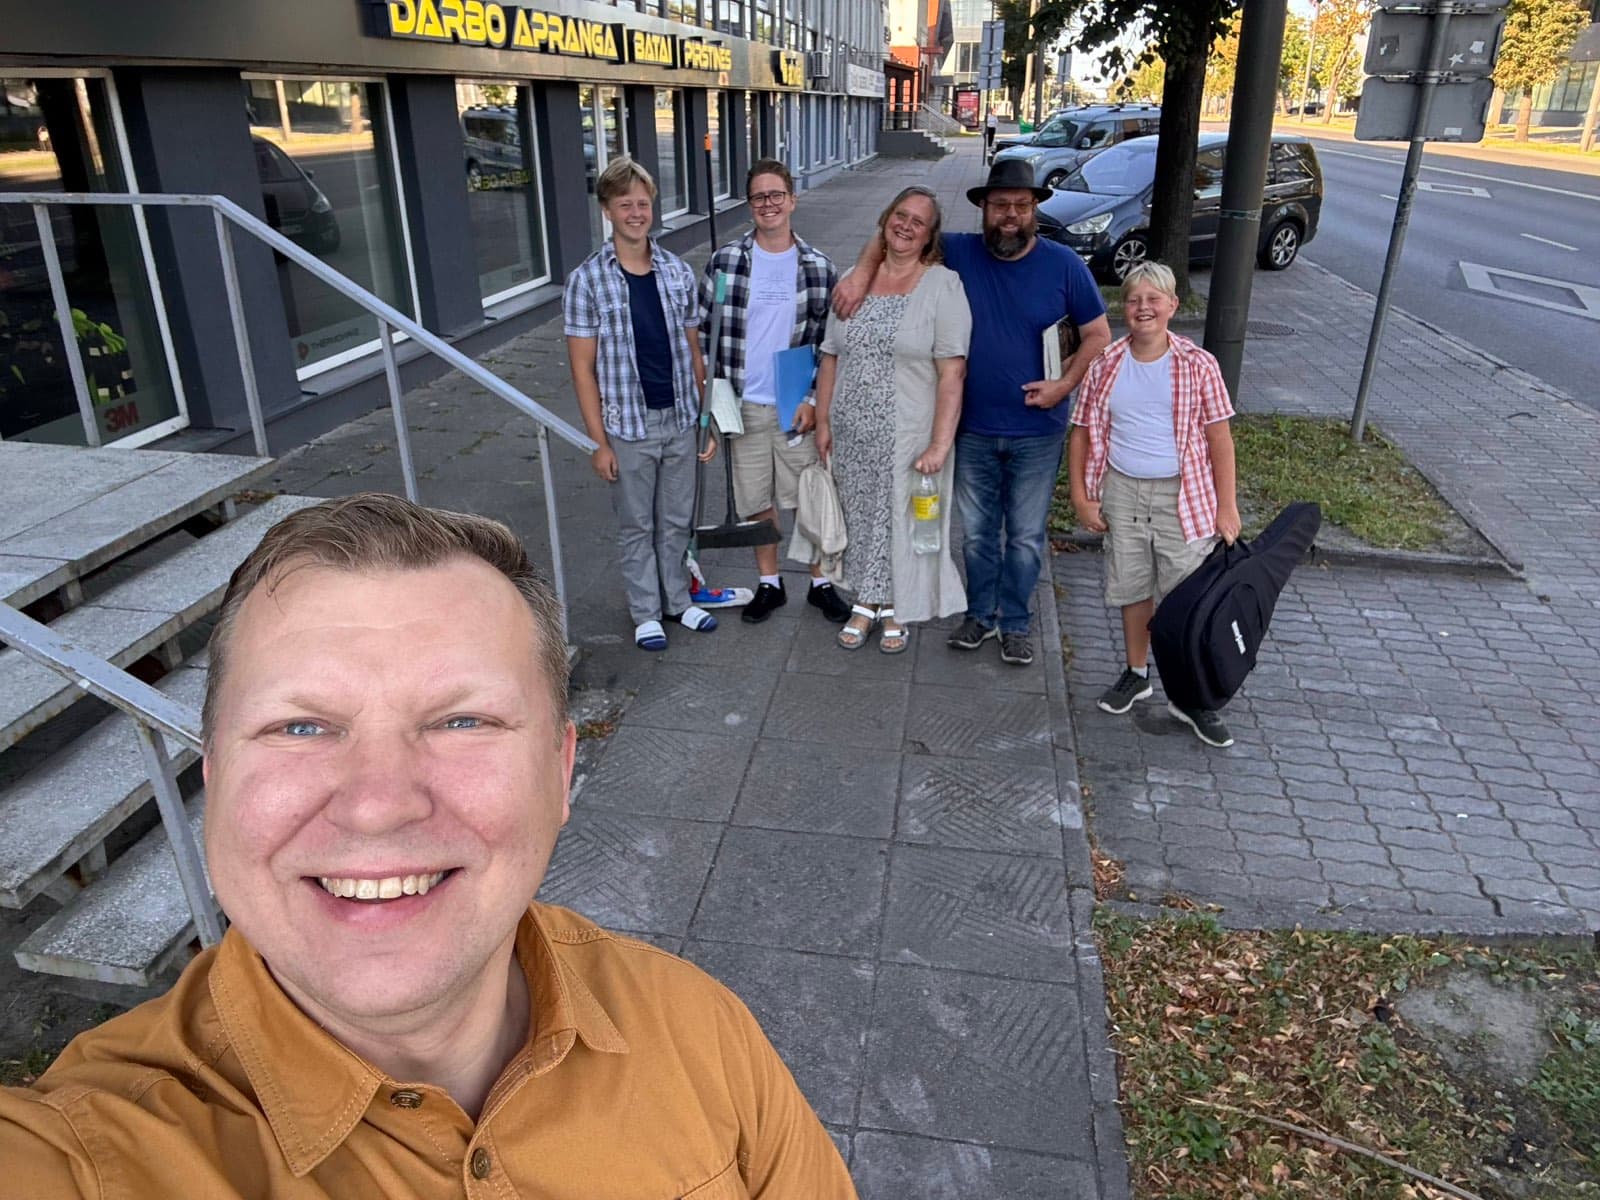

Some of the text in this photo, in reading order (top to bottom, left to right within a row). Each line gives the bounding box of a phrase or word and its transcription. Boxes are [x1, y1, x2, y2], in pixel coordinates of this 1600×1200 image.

[389, 0, 507, 45] DARBO
[513, 8, 619, 58] APRANGA
[633, 31, 673, 64] BATAI
[104, 401, 140, 433] 3M
